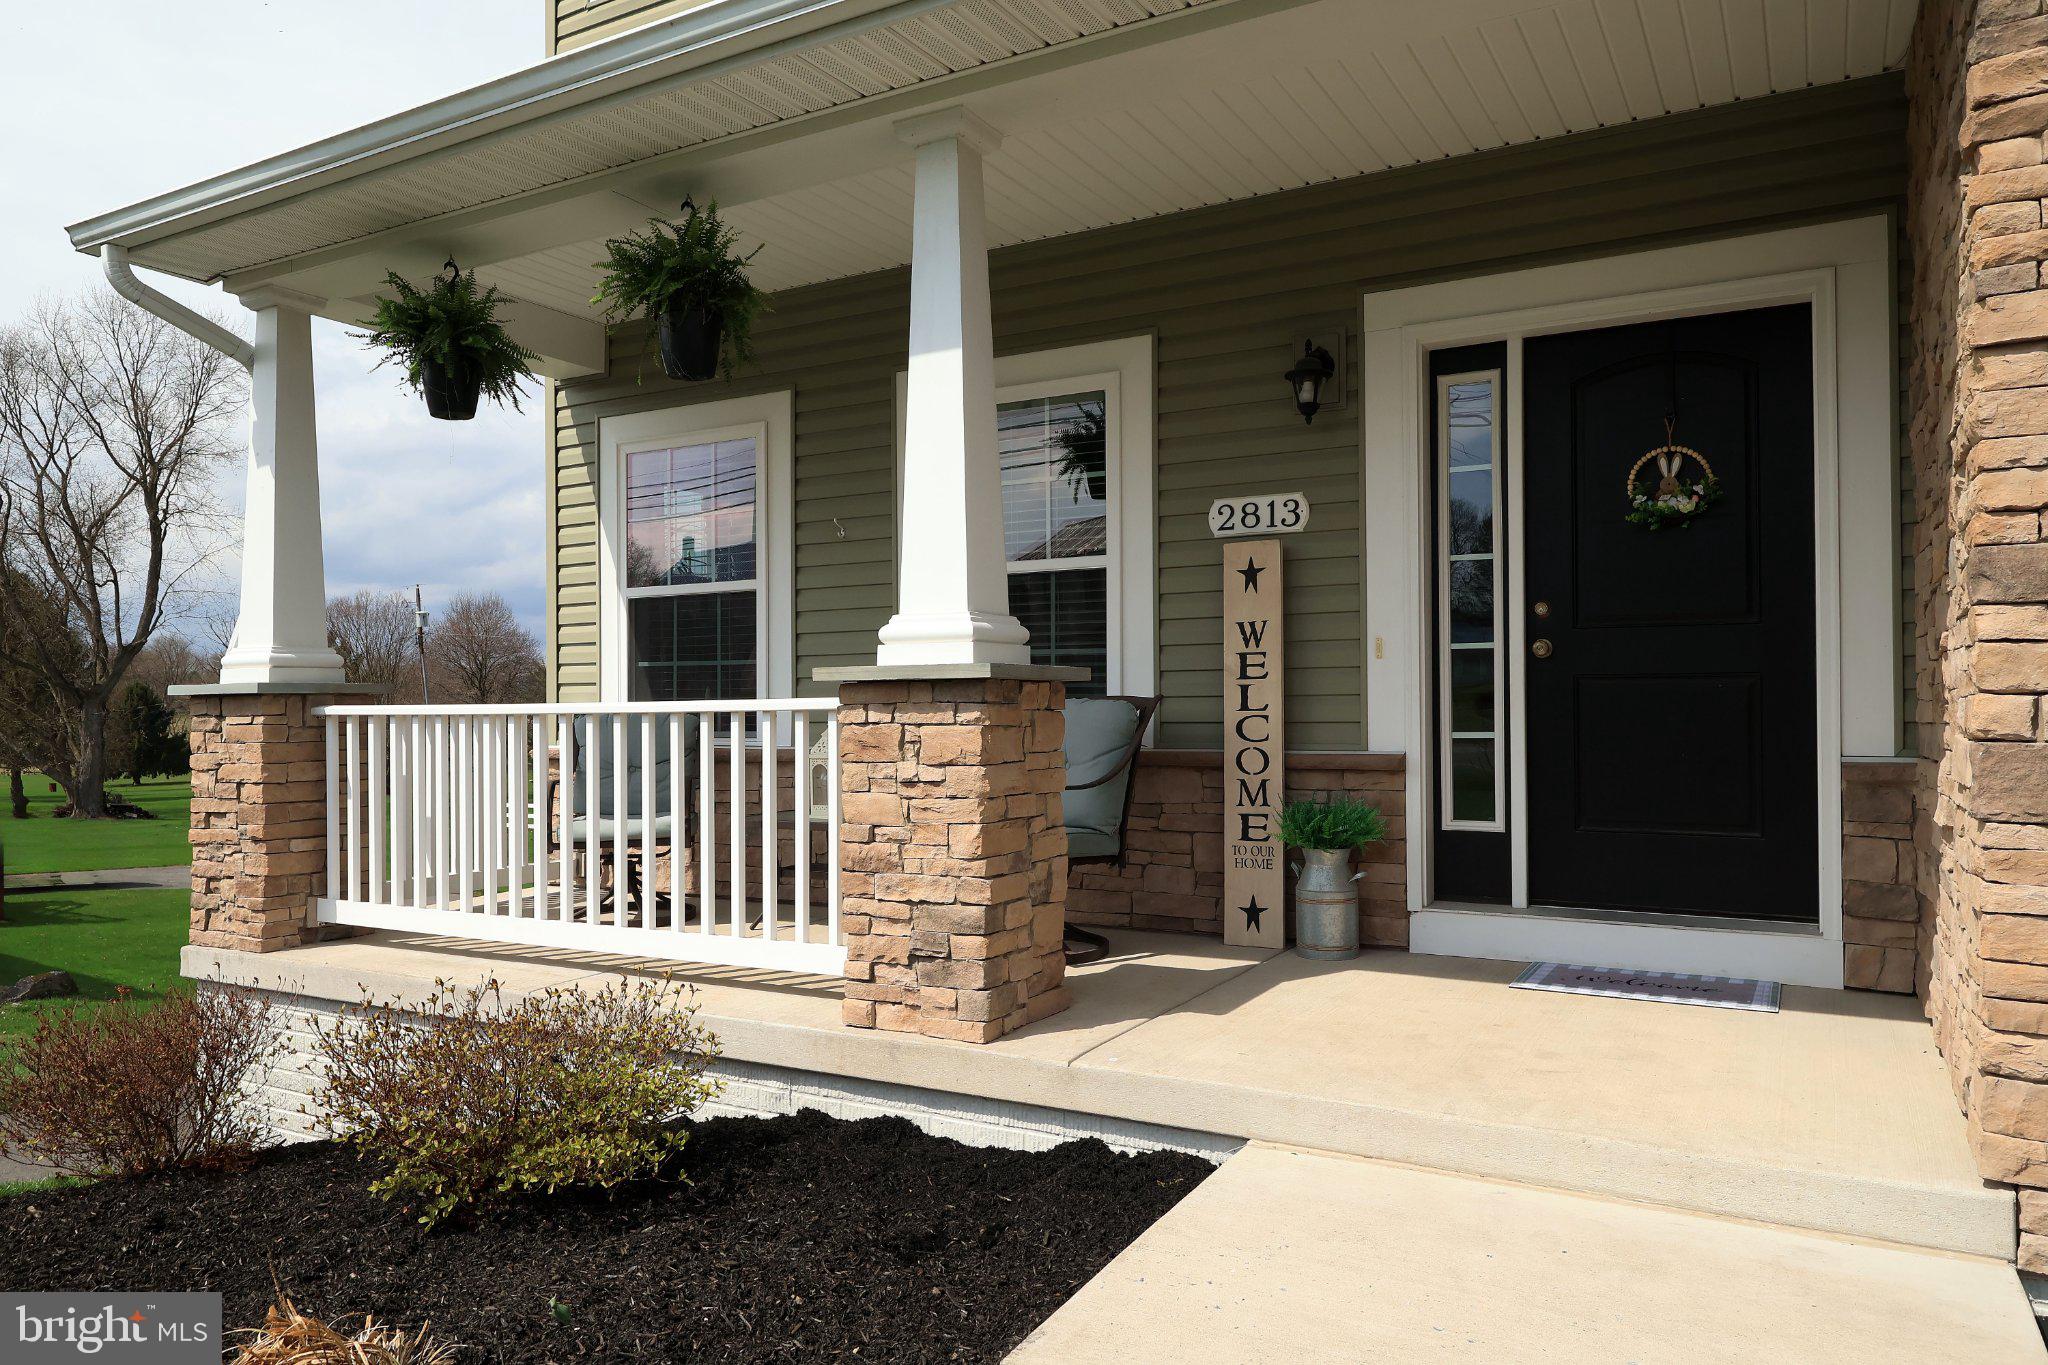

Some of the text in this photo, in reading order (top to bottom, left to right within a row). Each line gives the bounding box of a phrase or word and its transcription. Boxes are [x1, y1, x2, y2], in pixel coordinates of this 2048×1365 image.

[1217, 499, 1301, 531] 2813
[1235, 620, 1271, 842] WELCOME
[1232, 845, 1275, 858] TO OUR
[1234, 857, 1274, 870] HOME
